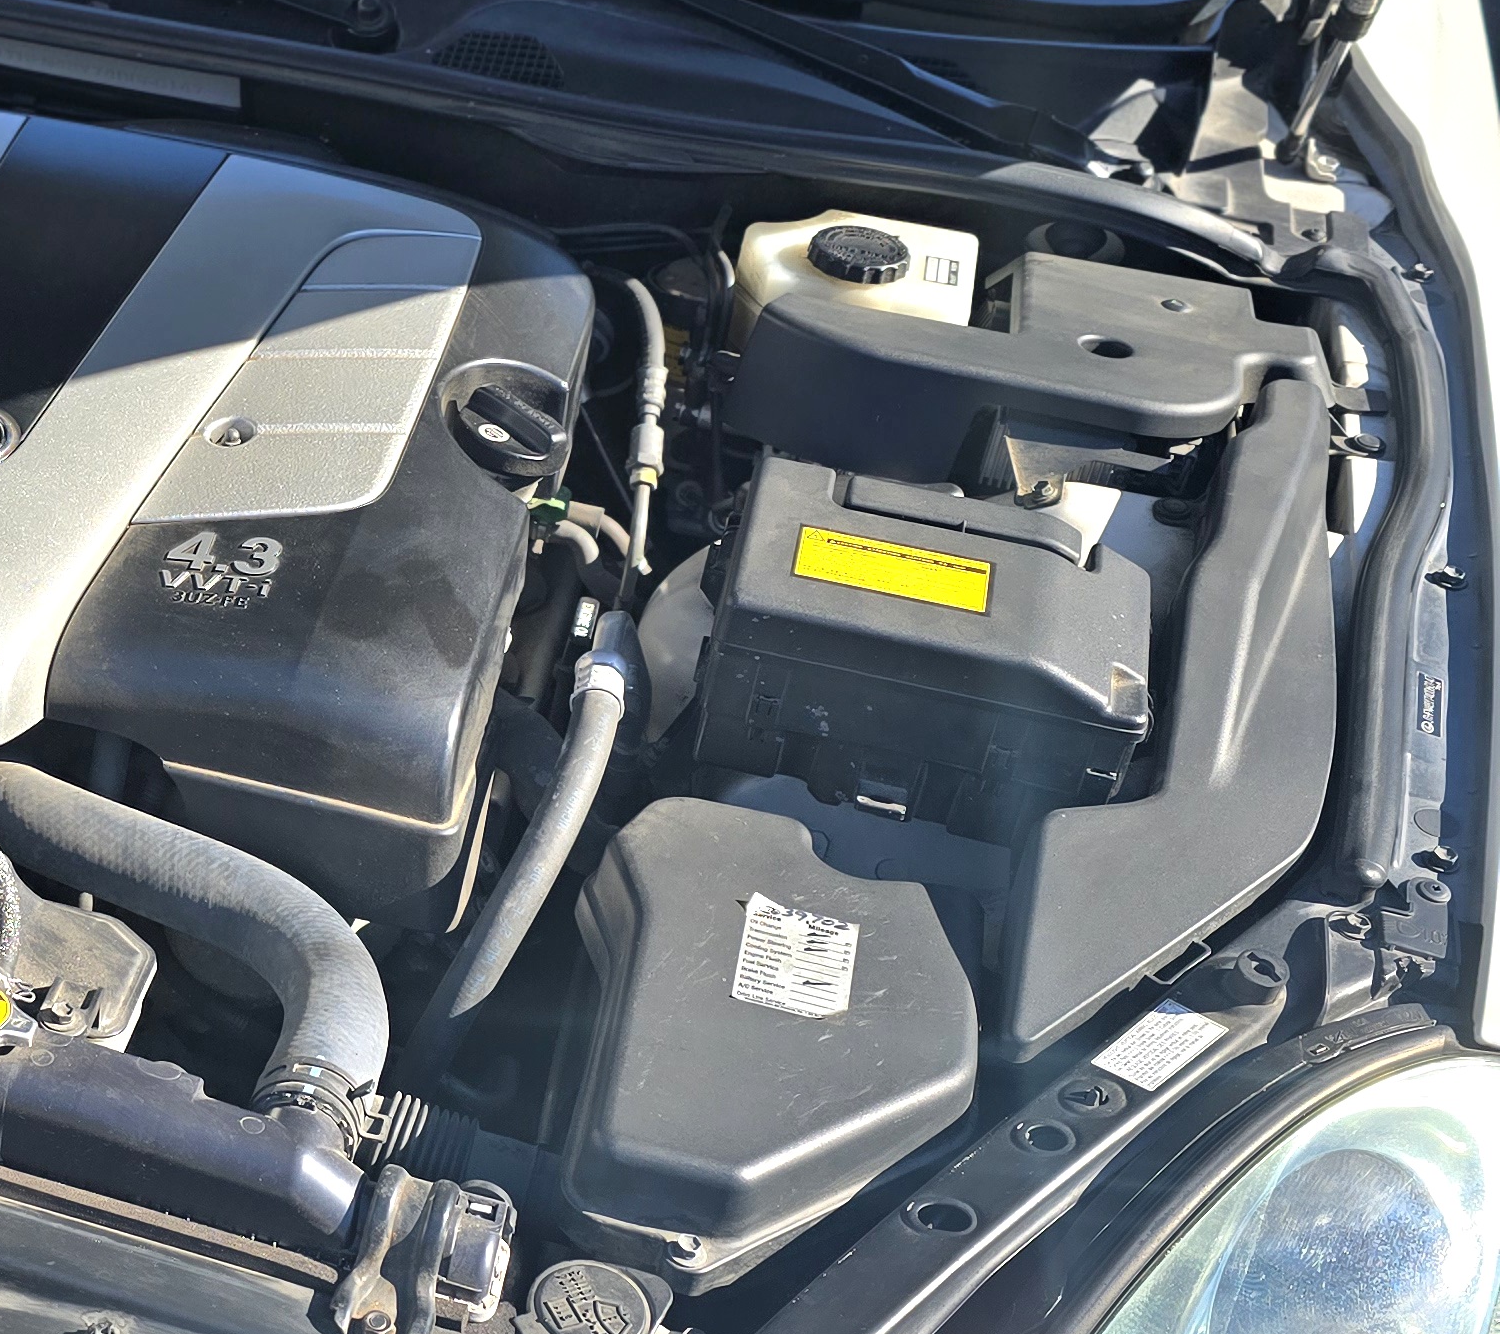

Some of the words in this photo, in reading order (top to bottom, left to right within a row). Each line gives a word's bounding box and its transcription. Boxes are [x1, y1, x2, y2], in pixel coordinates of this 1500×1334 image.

[163, 531, 283, 577] 4.3
[159, 569, 272, 598] VVT-i
[171, 591, 250, 609] 3UZ-FE
